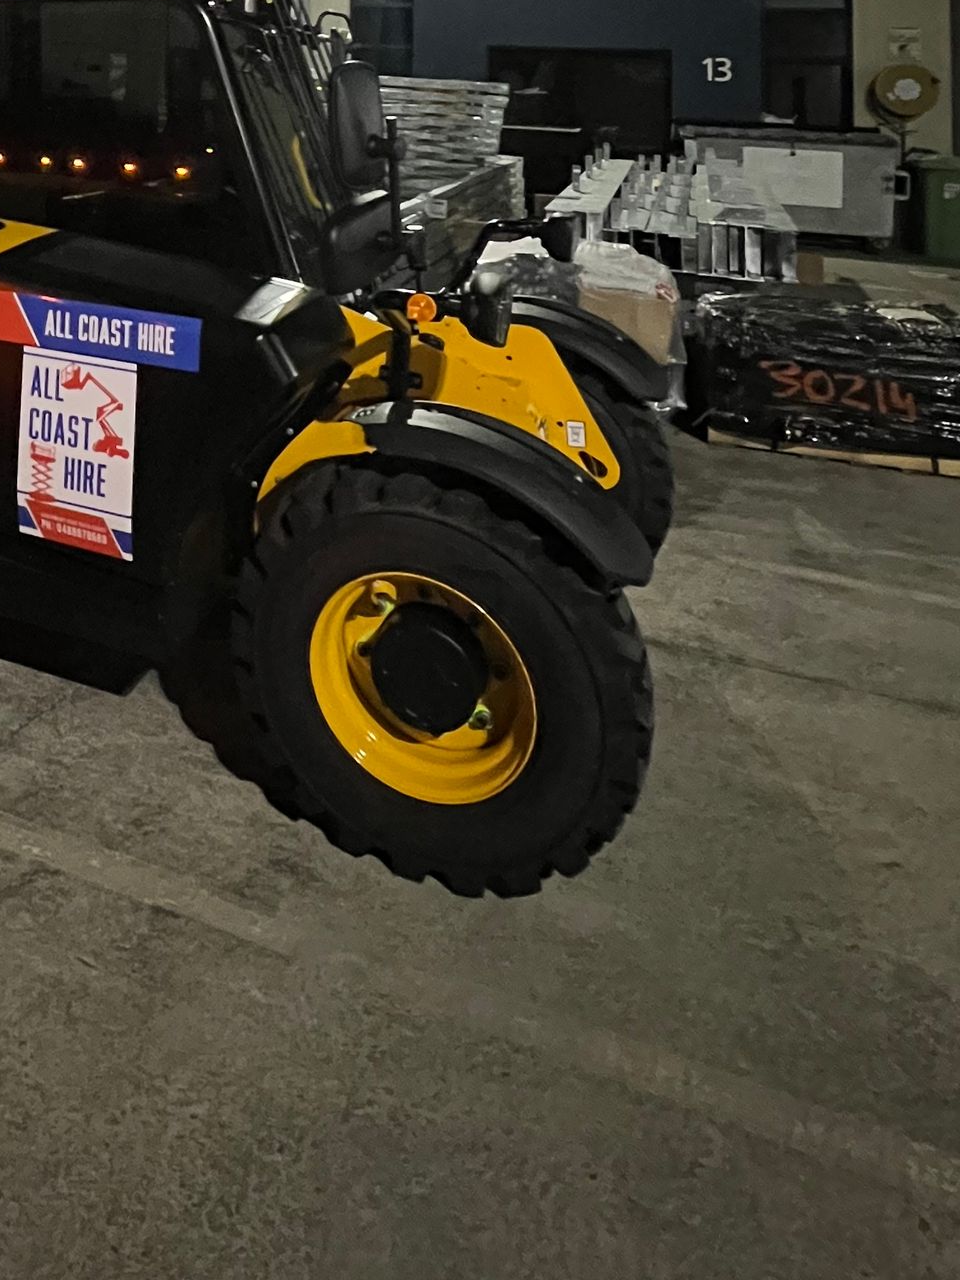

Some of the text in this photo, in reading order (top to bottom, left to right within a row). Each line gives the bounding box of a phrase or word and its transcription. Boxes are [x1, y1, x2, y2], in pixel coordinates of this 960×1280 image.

[701, 57, 733, 83] 13
[44, 308, 177, 356] ALL COAST HIRE
[30, 365, 65, 402] ALL
[28, 407, 94, 451] COAST
[63, 455, 107, 498] HIRE
